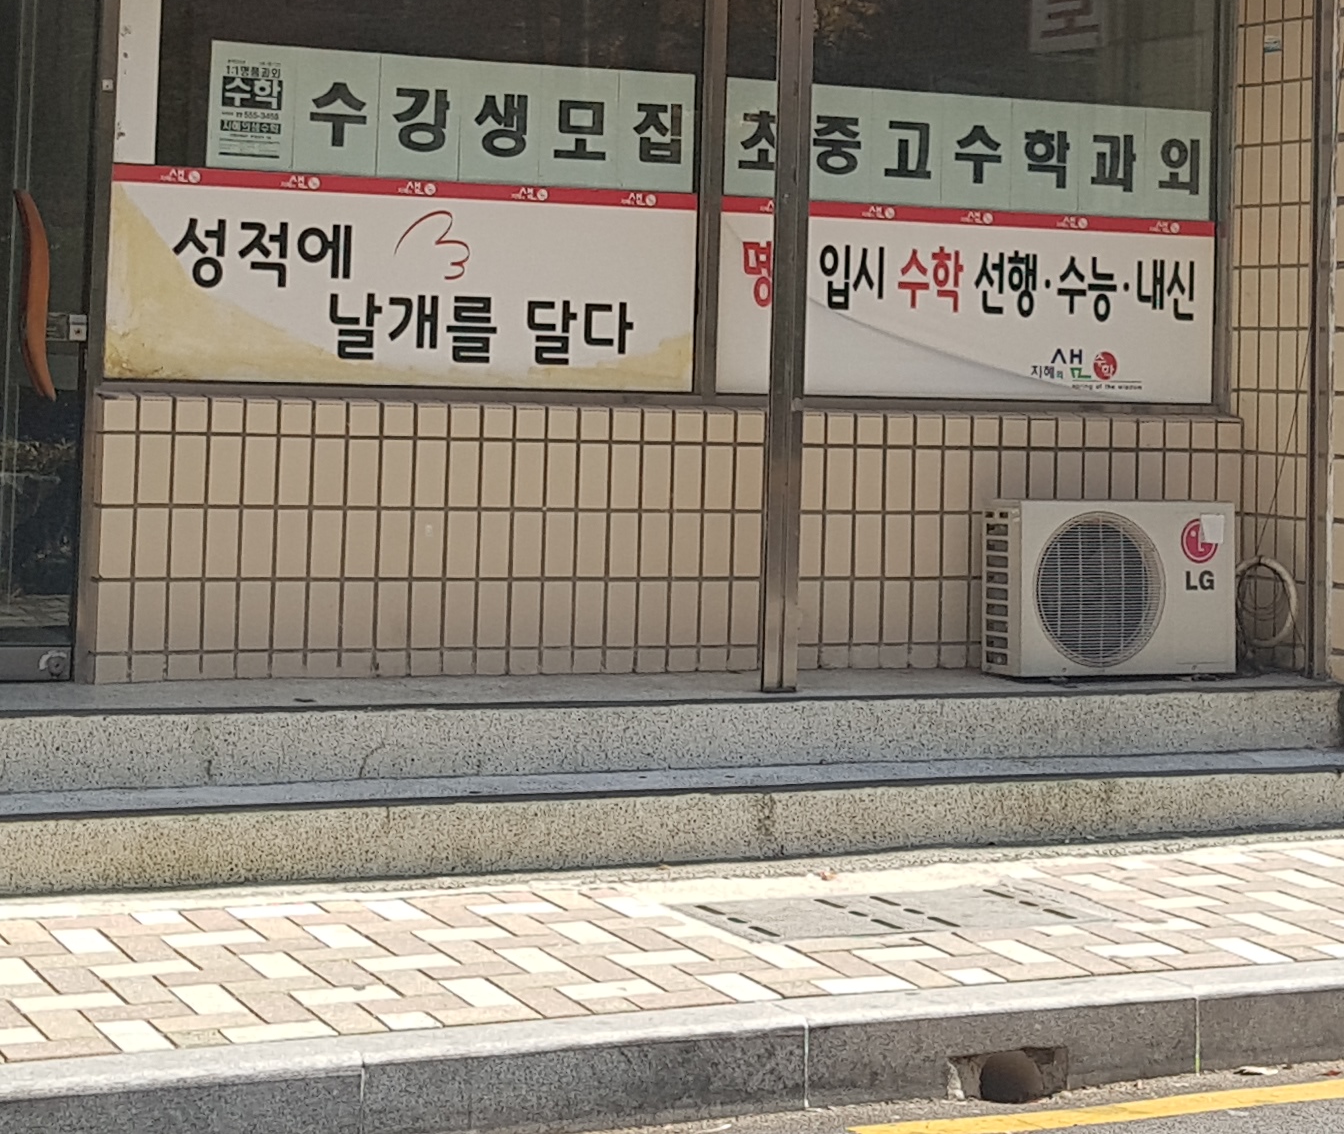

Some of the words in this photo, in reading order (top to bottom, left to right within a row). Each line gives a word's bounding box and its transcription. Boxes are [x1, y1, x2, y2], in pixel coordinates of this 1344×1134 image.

[223, 76, 282, 110] 수학
[308, 81, 684, 165] 수강생모집
[172, 217, 353, 289] 성적에
[818, 244, 886, 311] 입시
[897, 246, 964, 313] 수학
[328, 292, 499, 364] 날개를
[526, 298, 635, 366] 달다
[1185, 570, 1216, 591] LG
